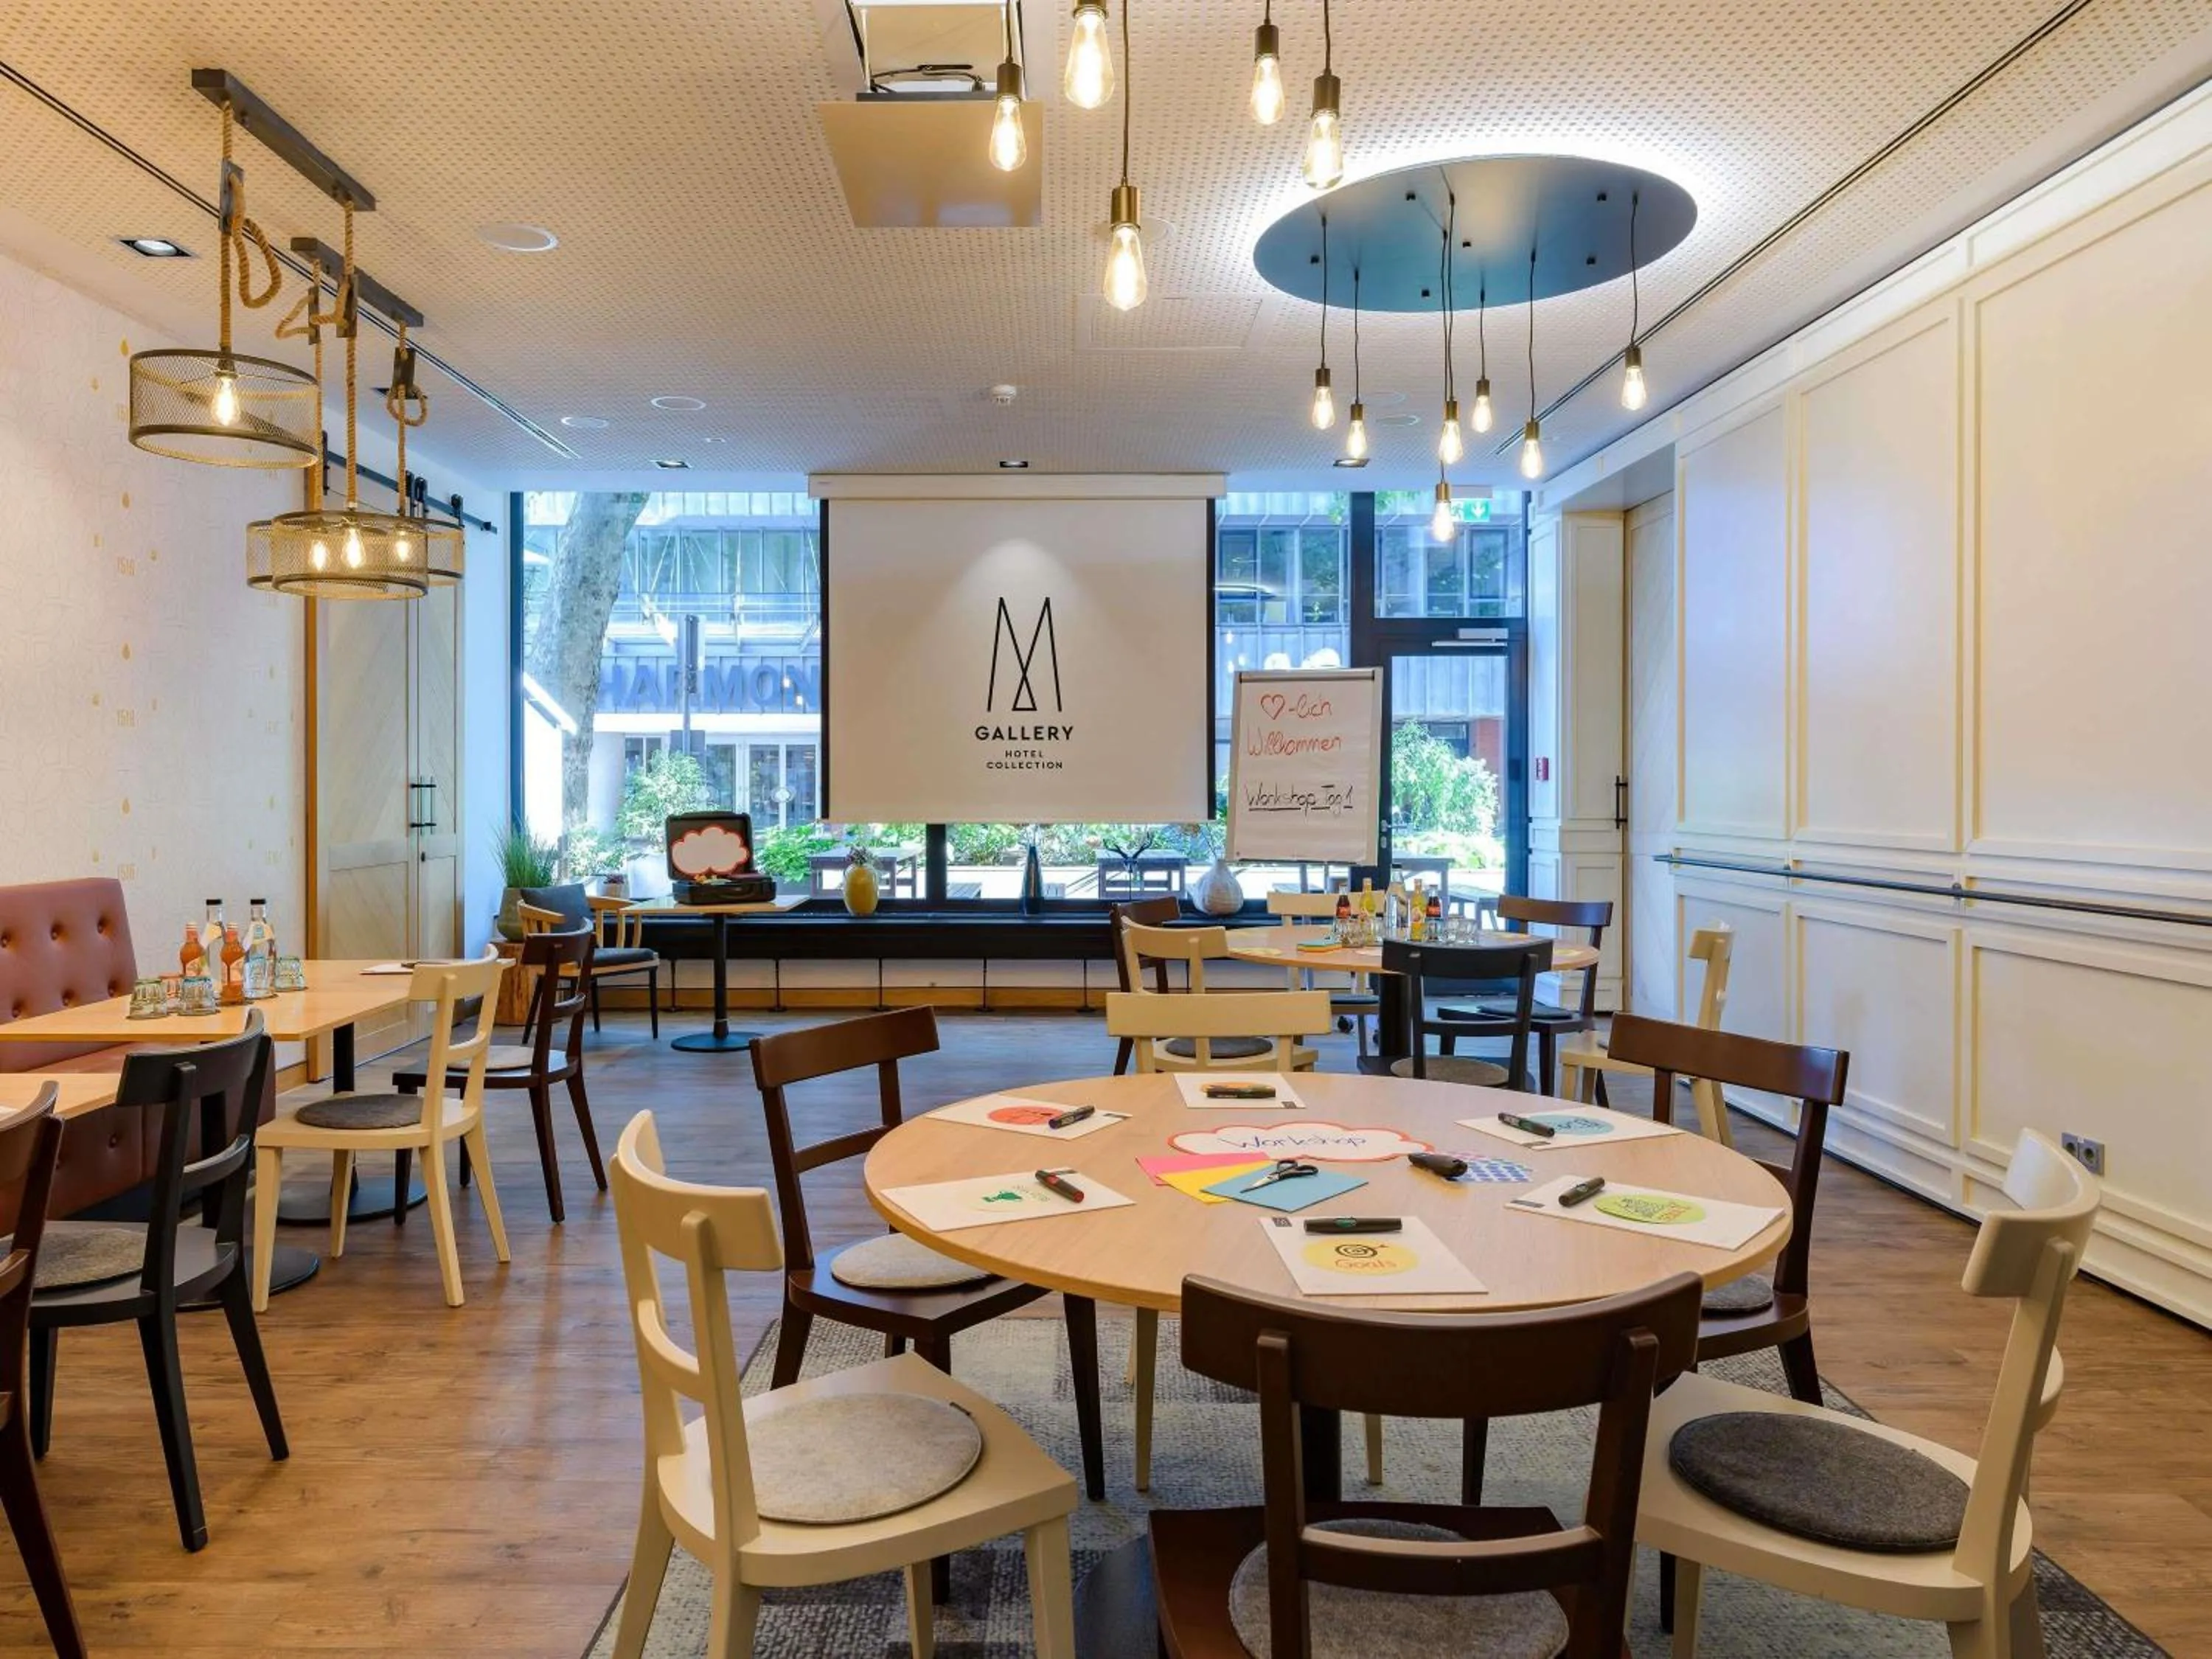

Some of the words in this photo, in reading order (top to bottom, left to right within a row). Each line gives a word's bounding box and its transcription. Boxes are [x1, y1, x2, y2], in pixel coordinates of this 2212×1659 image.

[974, 726, 1074, 741] GALLERY
[1247, 723, 1342, 756] Willkommen
[1004, 750, 1044, 758] HOTEL
[986, 762, 1063, 770] COLLECTION
[1244, 782, 1317, 818] Workshop
[1346, 785, 1354, 804] 1
[1217, 1133, 1367, 1148] Workshop
[1334, 1258, 1397, 1269] Goals
